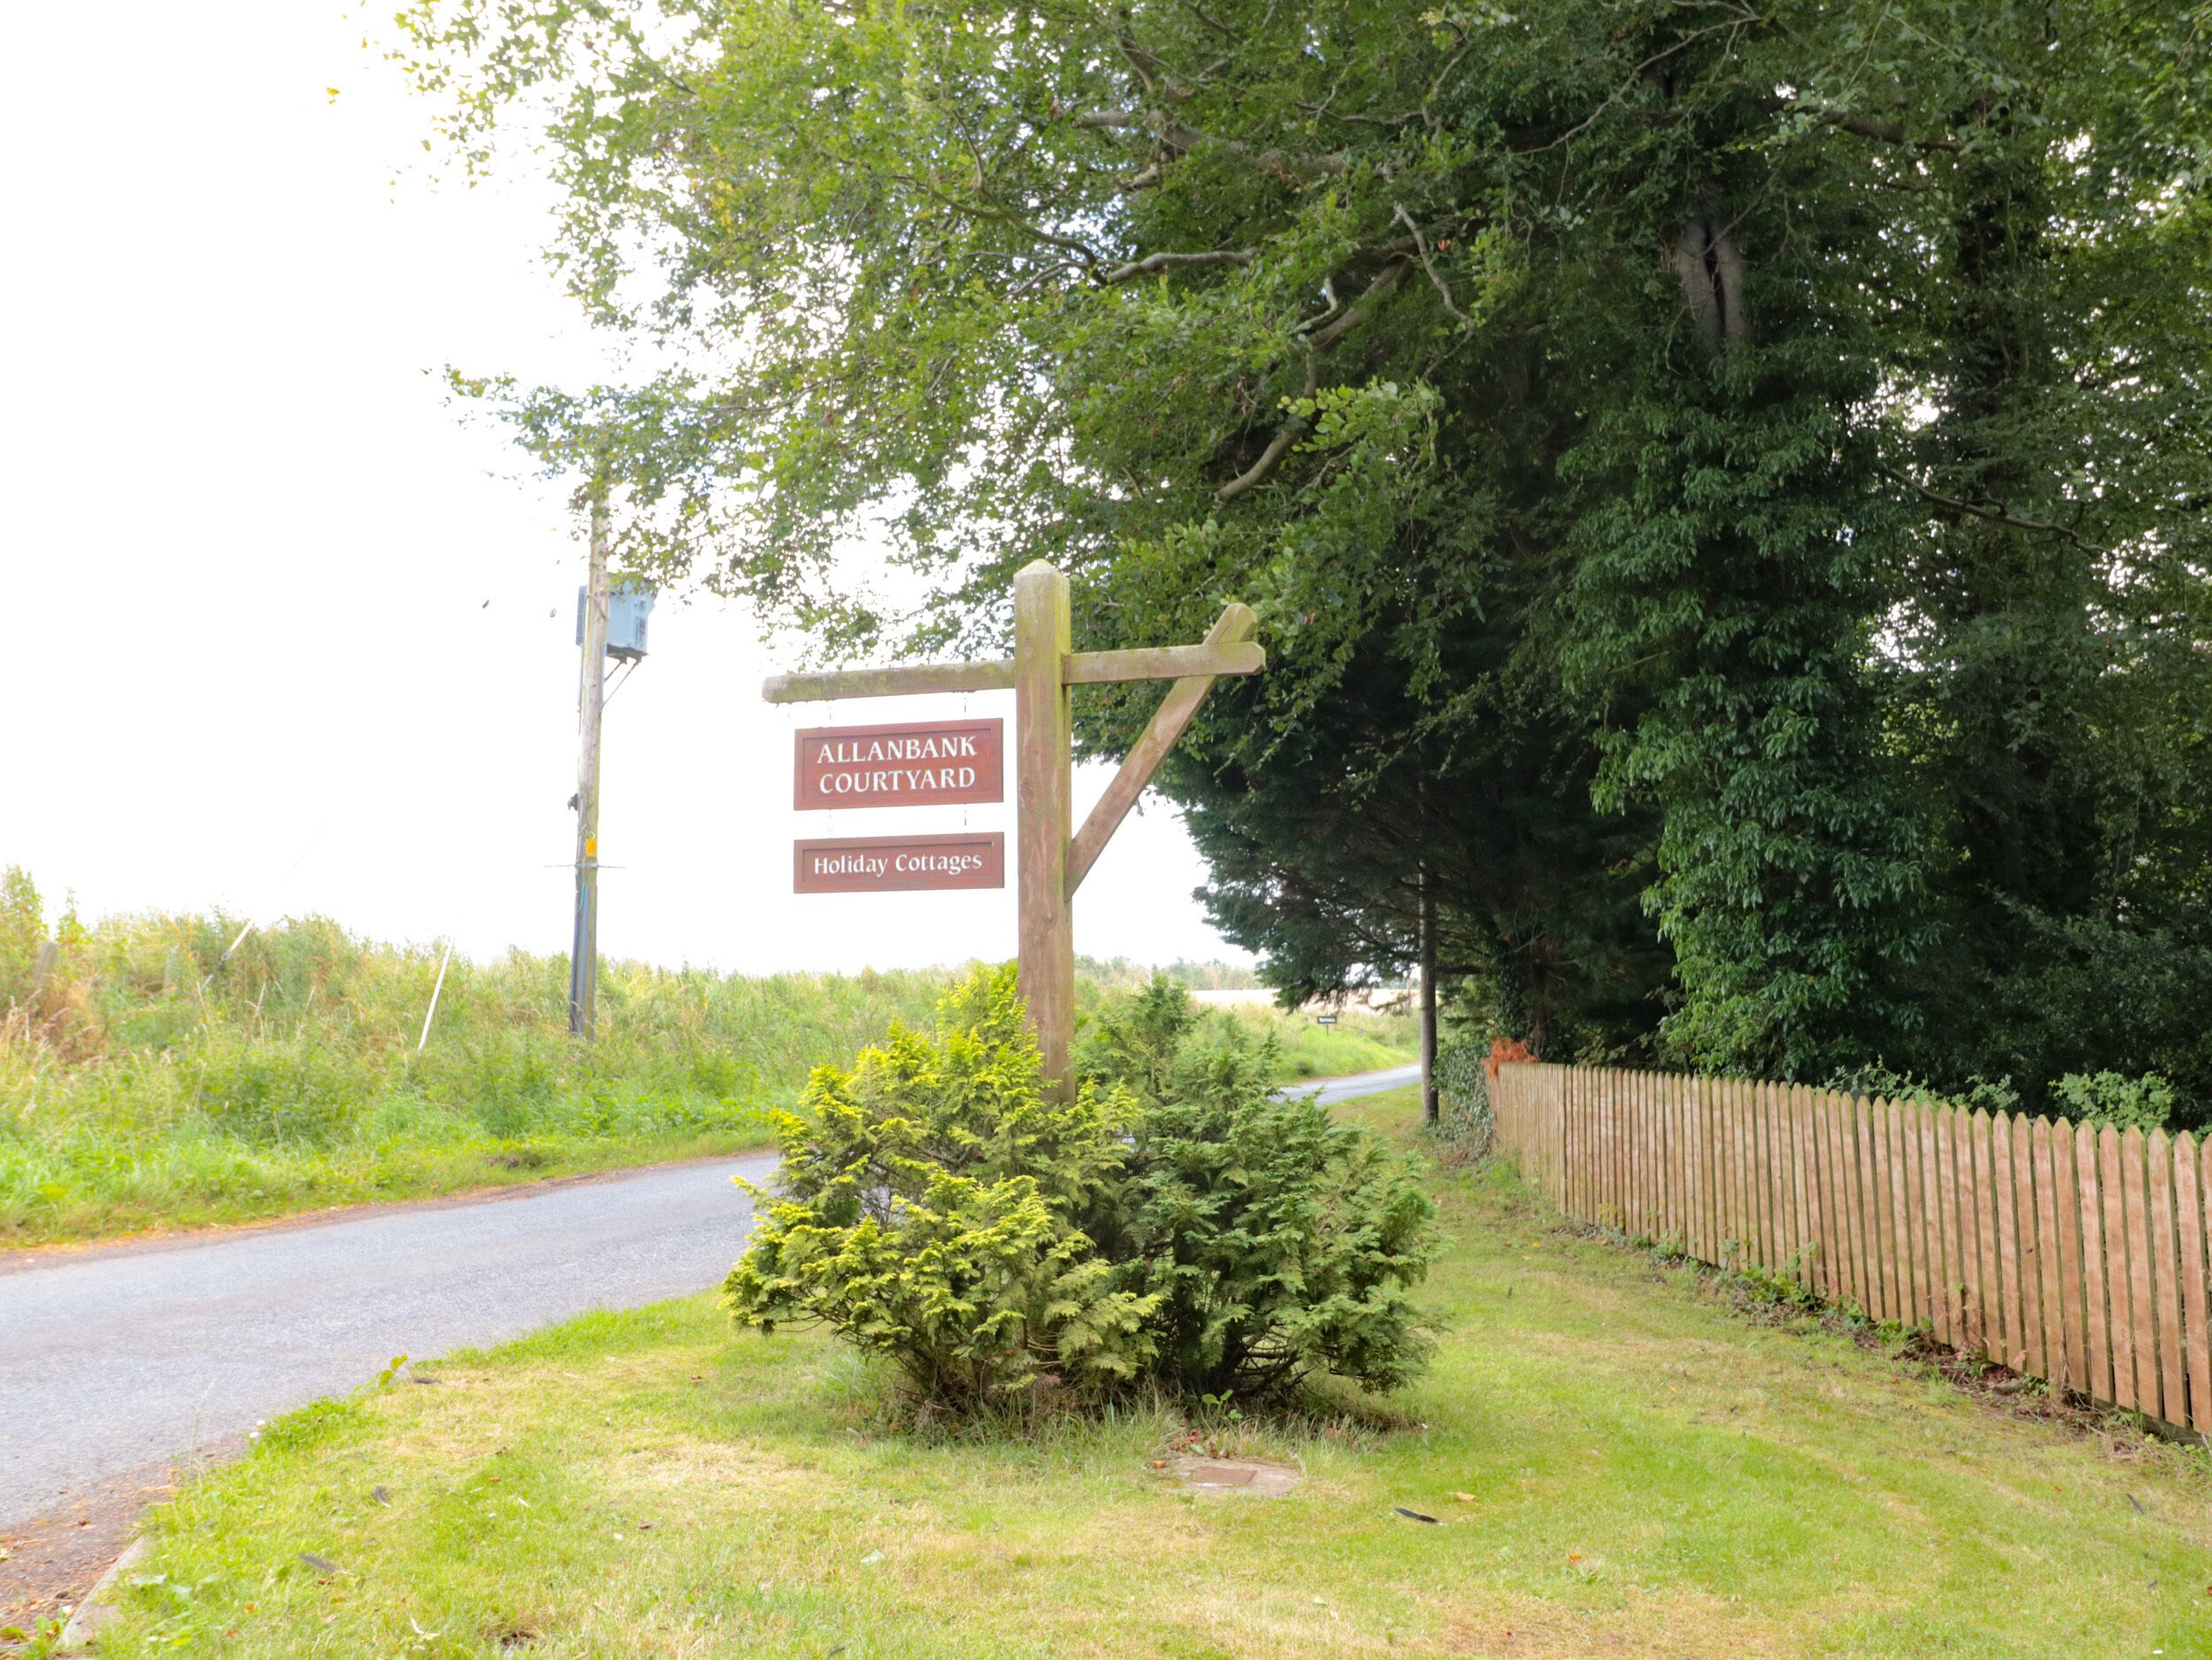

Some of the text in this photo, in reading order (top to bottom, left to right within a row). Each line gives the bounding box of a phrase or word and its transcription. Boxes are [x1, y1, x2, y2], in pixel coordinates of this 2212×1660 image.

[816, 736, 978, 764] ALLANBANK
[819, 767, 976, 794] COURTYARD
[814, 853, 983, 878] Holiday Cottages
